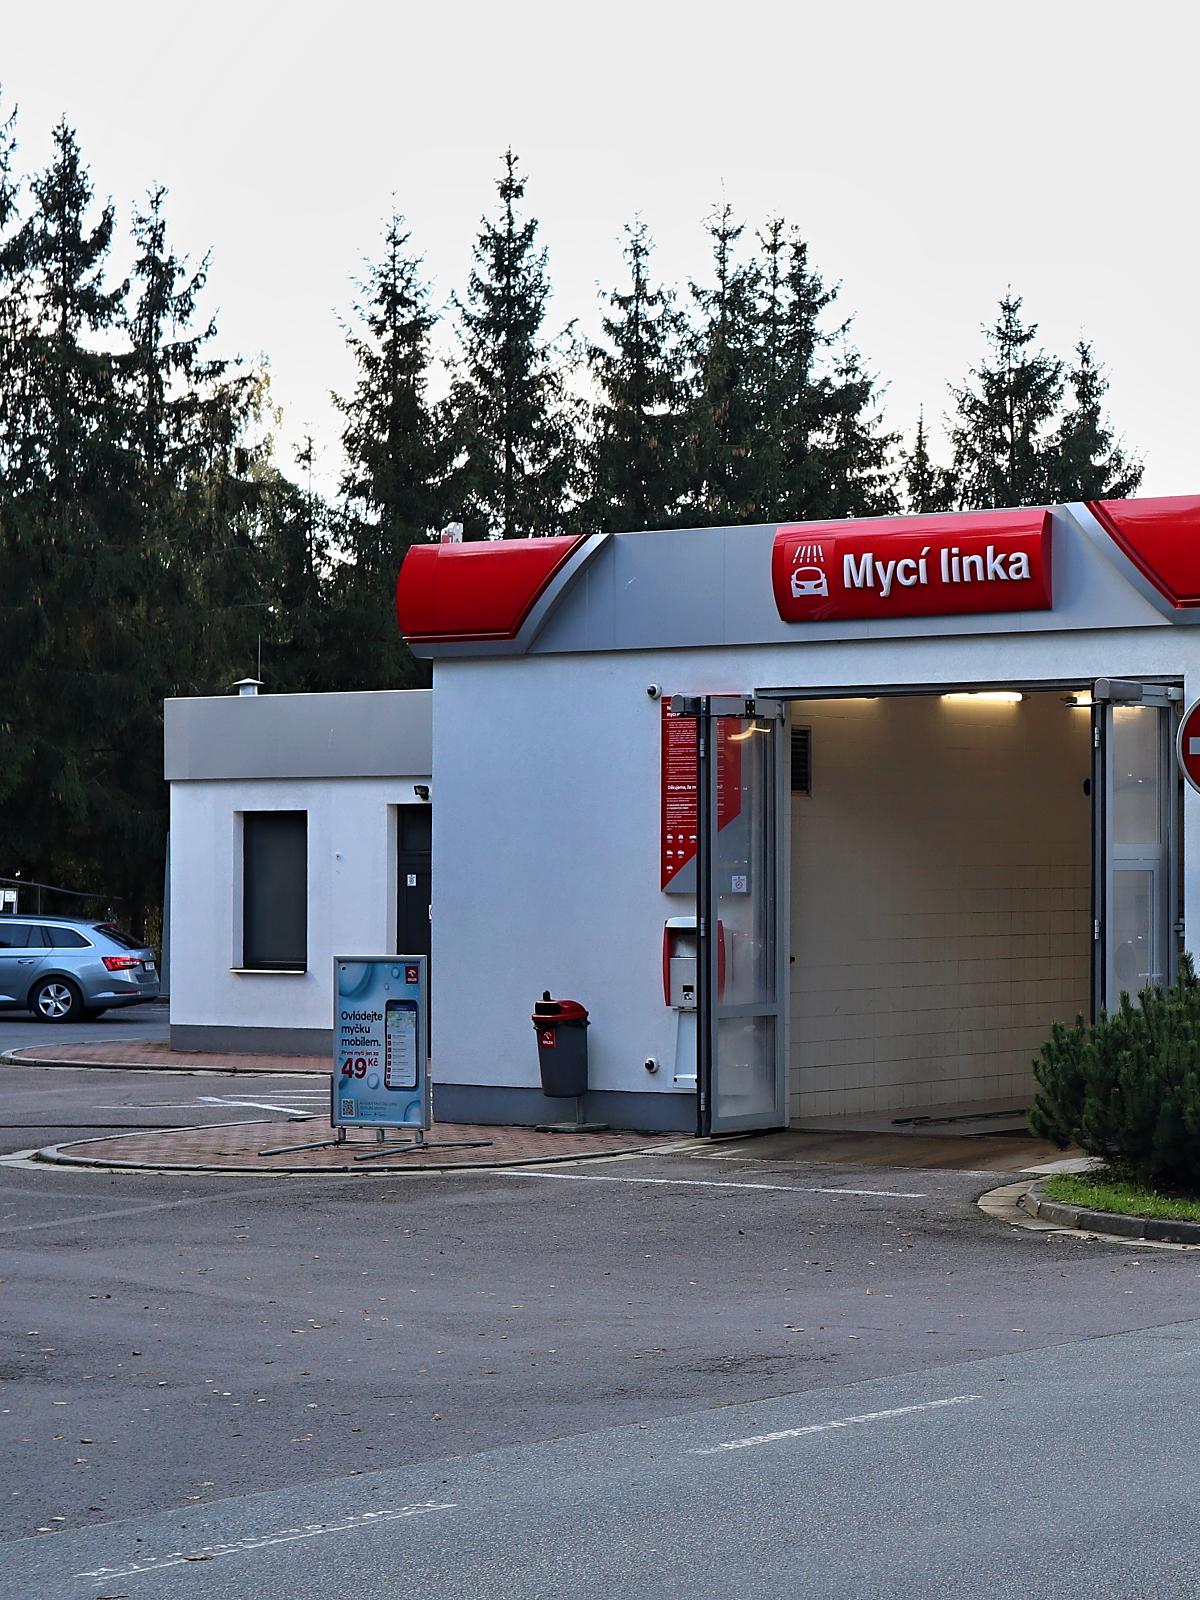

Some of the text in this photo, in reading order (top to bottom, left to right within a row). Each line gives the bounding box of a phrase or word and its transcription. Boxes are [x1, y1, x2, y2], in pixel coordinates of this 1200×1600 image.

[842, 545, 1032, 598] Mycí linka
[341, 1010, 383, 1023] Ovládejte
[341, 1024, 371, 1035] myčku
[341, 1036, 381, 1047] mobilem.
[341, 1057, 379, 1079] 49 Kč
